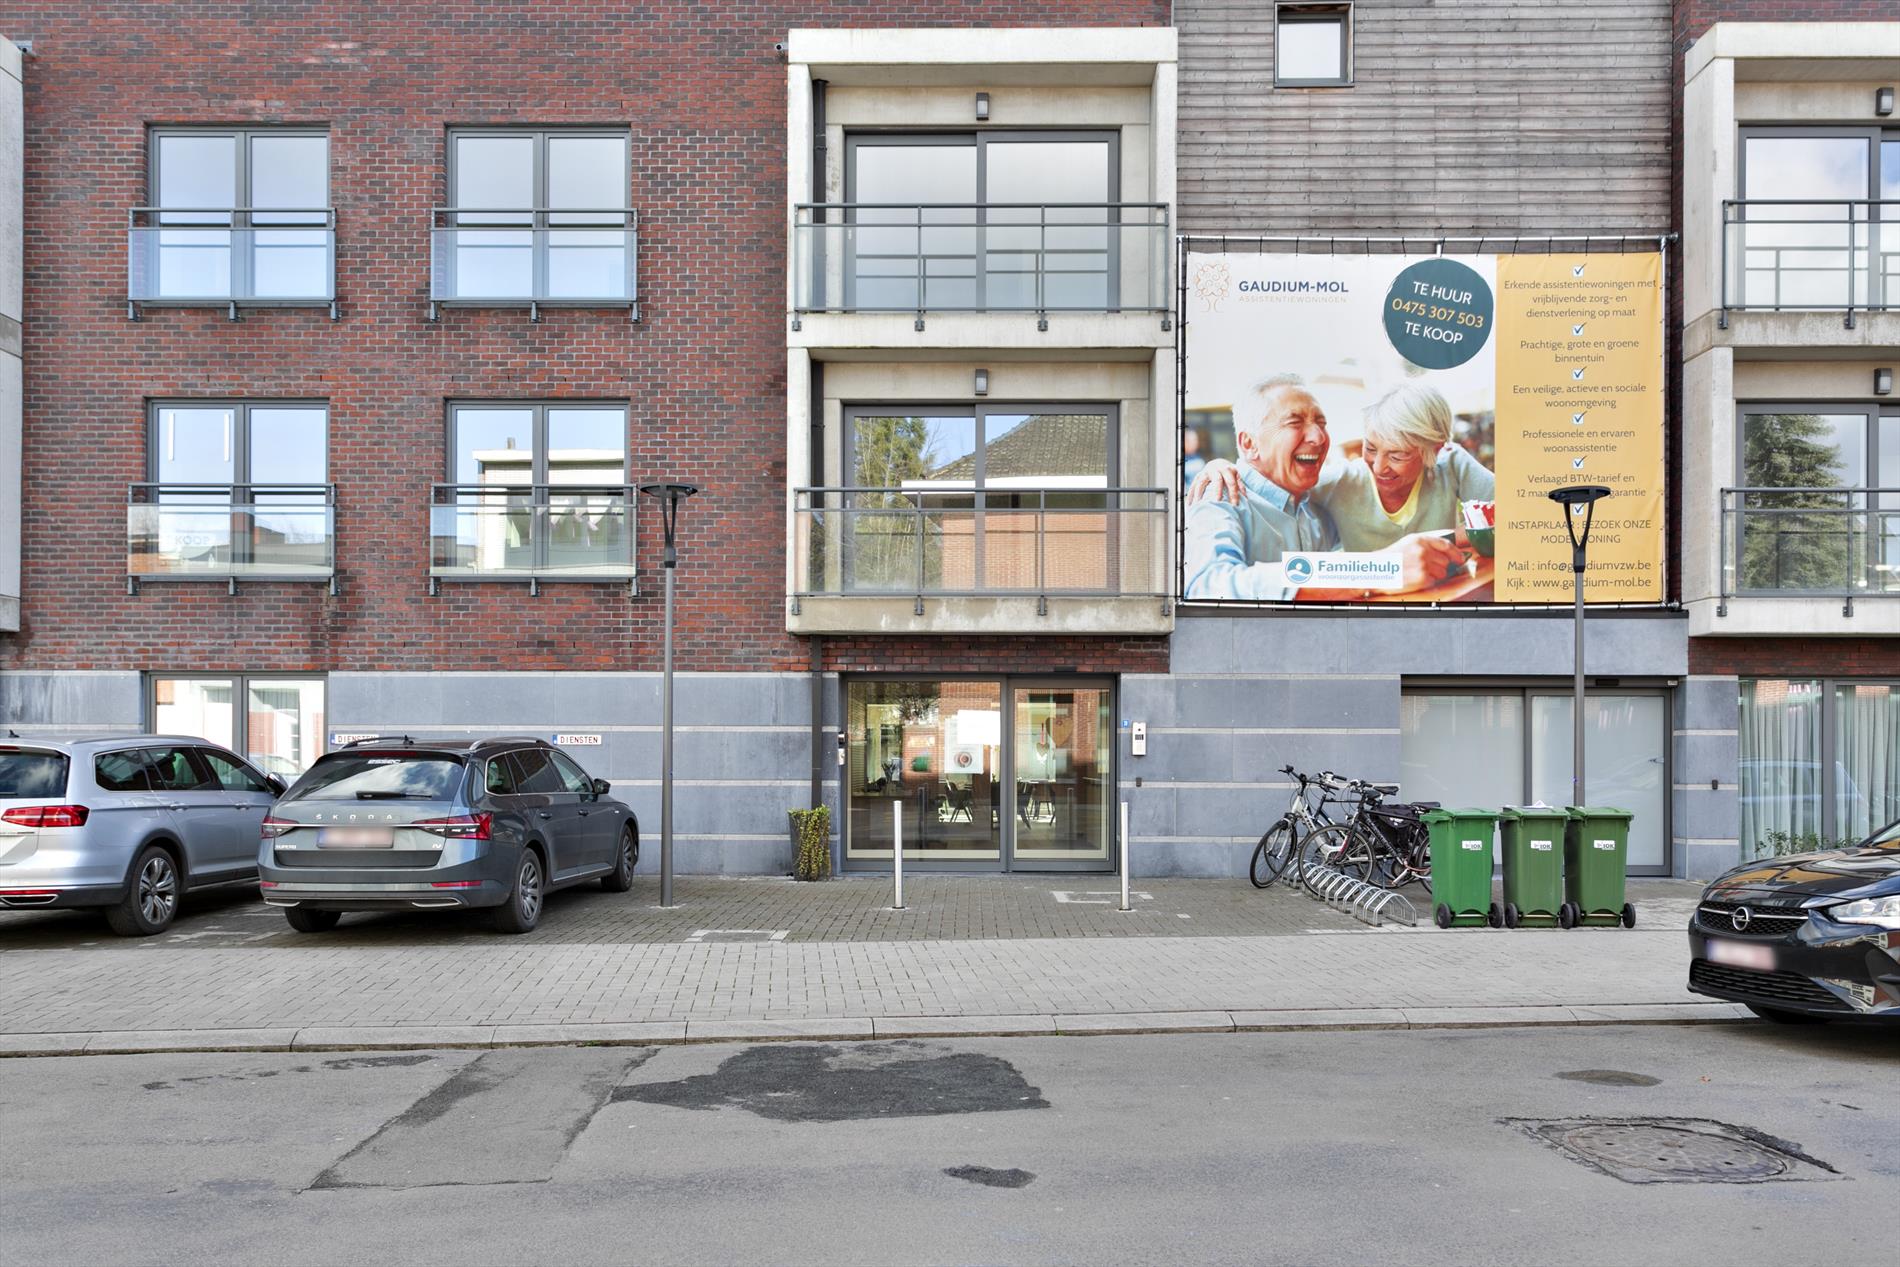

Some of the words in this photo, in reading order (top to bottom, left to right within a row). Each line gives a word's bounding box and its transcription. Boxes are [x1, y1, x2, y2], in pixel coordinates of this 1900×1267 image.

[1238, 280, 1349, 292] GAUDIUM-MOL
[1504, 280, 1541, 289] Erkende
[1543, 280, 1635, 290] assistentiewoningen
[1637, 280, 1656, 288] met
[1413, 281, 1429, 296] TE
[1431, 285, 1472, 304] HUUR
[1532, 294, 1586, 305] vrijblijvende
[1589, 295, 1613, 304] zorg-
[1392, 298, 1426, 316] 0475
[1428, 306, 1456, 322] 307
[1456, 312, 1484, 328] 503
[1526, 309, 1596, 319] dienstverlening
[1598, 309, 1610, 318] op
[1405, 321, 1421, 336] TE
[1423, 325, 1463, 344] KOOP
[1520, 341, 1565, 351] Prachtige,
[1567, 341, 1591, 350] grote
[1607, 340, 1639, 350] groene
[1555, 354, 1605, 363] binnentuin
[1513, 385, 1530, 394] Een
[1533, 385, 1564, 395] veilige,
[1566, 385, 1599, 393] actieve
[1615, 383, 1646, 392] sociale
[1545, 399, 1616, 409] woonomgeving
[1523, 430, 1584, 439] Professionele
[1543, 444, 1617, 453] woonassistentie
[1528, 474, 1568, 485] Verlaagd
[1570, 474, 1621, 483] BTW-tarief
[1517, 489, 1526, 497] 12
[1609, 488, 1646, 499] garantie
[1582, 520, 1621, 529] BEZOEK
[1623, 519, 1651, 529] ONZE
[1541, 534, 1621, 544] MODEWONING
[1318, 560, 1400, 574] Familiehulp
[1508, 561, 1530, 571] Mail
[1537, 560, 1651, 573] info@gdiumvzw.be
[1507, 578, 1525, 590] Kijk
[1533, 576, 1651, 590] www.gadium-mol.be
